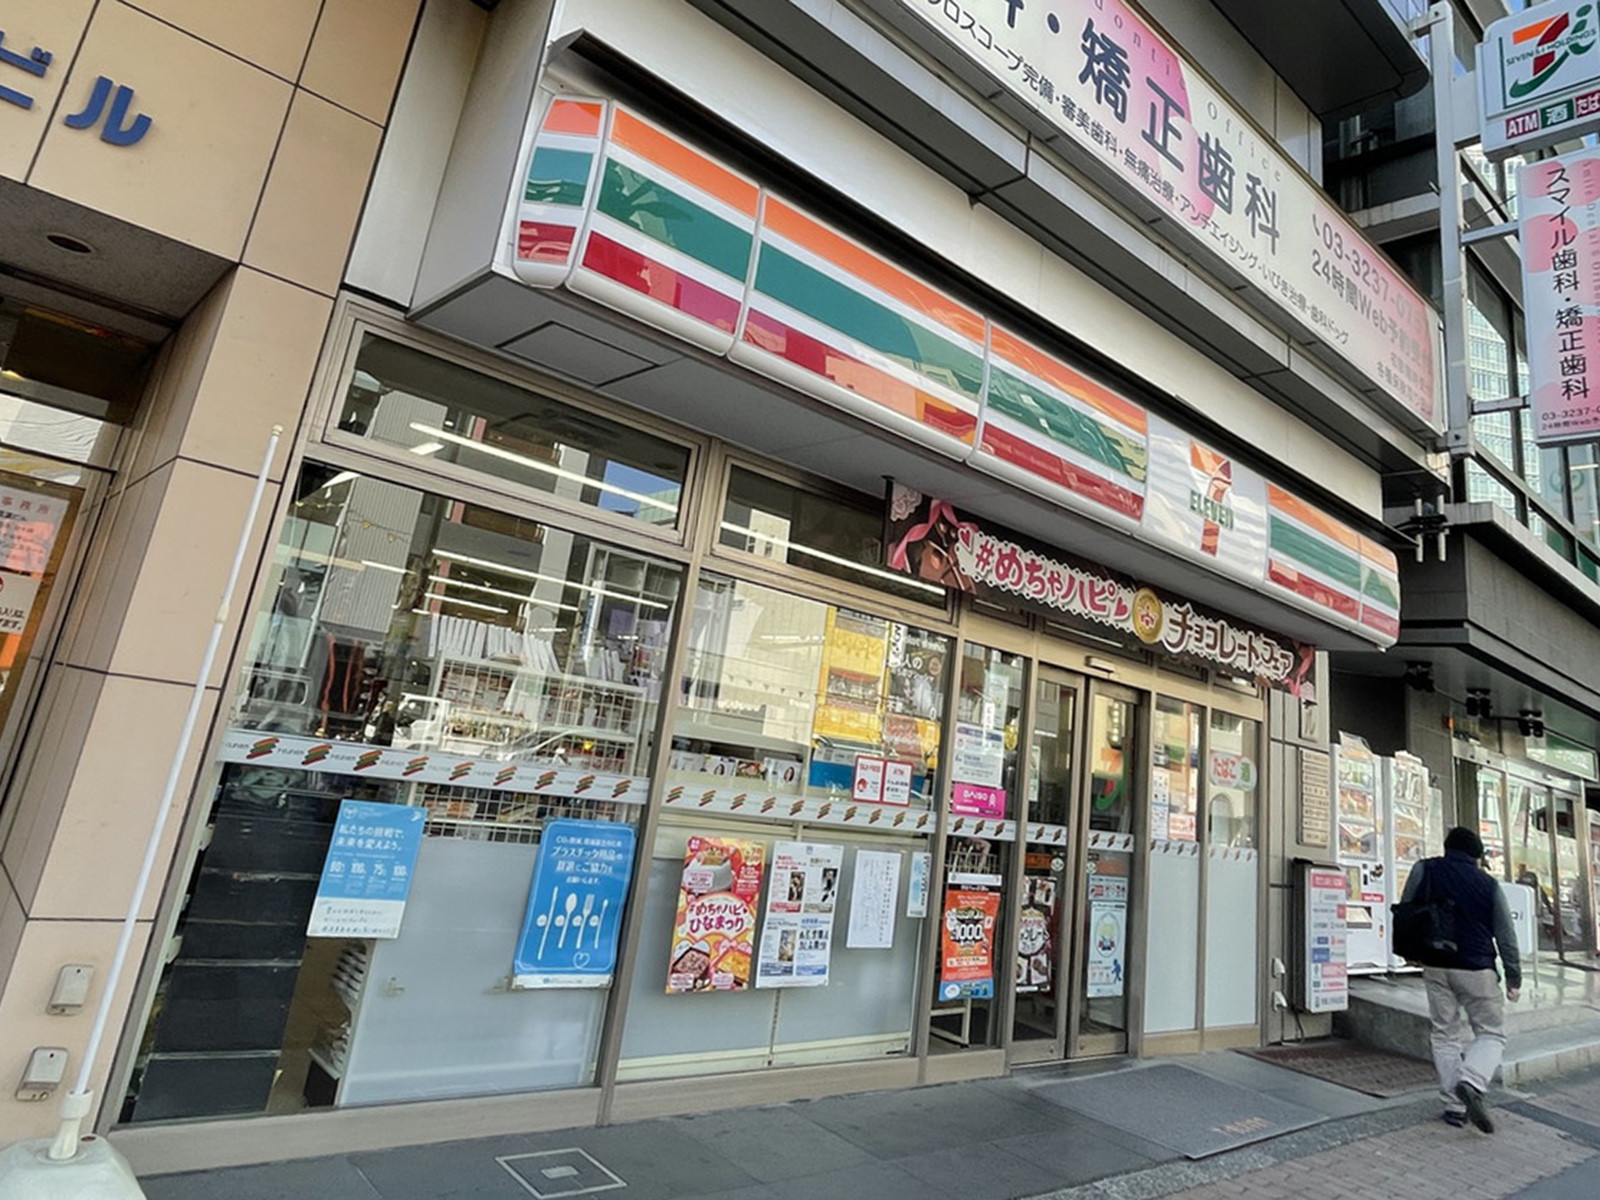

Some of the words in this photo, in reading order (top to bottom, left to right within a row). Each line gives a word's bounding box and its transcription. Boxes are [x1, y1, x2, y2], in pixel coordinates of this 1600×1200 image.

[1206, 101, 1281, 182] Office
[1508, 111, 1539, 137] ATM
[1546, 167, 1590, 400] スマイル歯科・矯正歯科
[1189, 489, 1234, 531] ELEVEN
[975, 539, 1116, 612] #めちゃハピ
[1165, 607, 1291, 674] チョコレートフェア
[689, 915, 744, 933] ひなまつり
